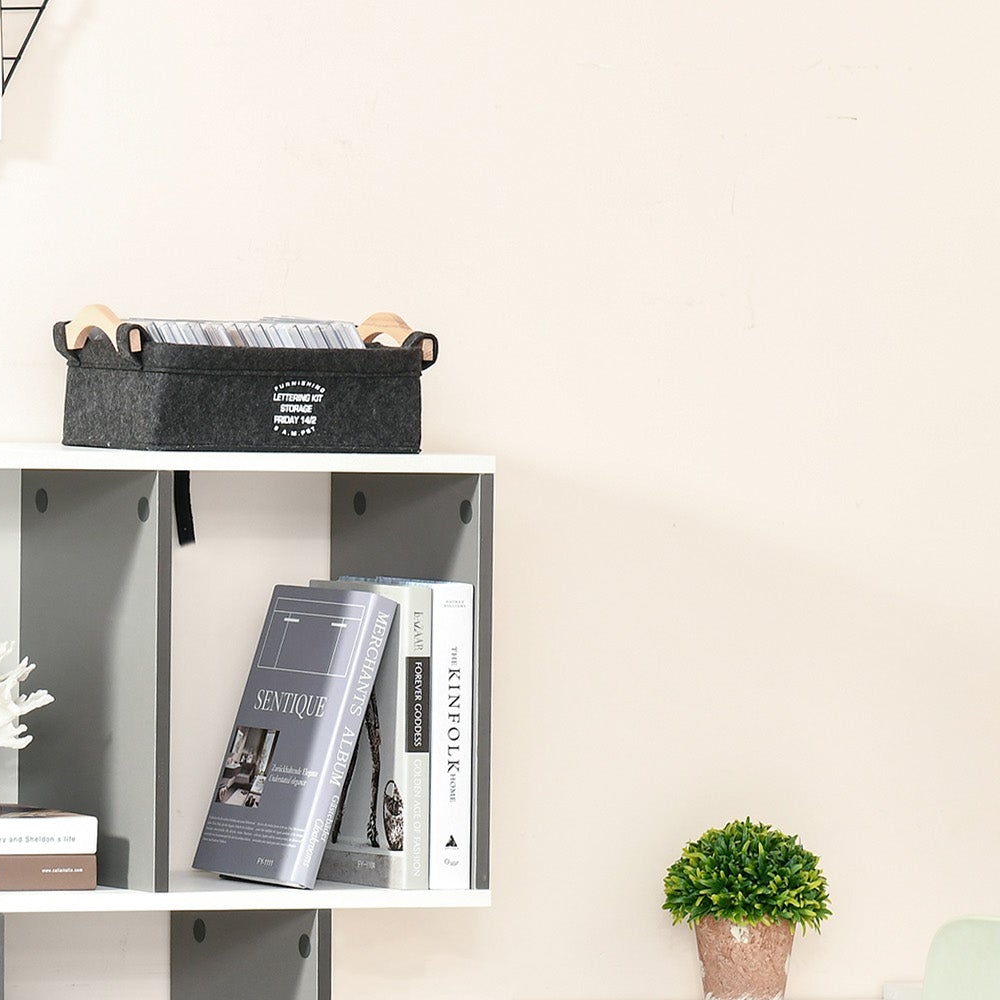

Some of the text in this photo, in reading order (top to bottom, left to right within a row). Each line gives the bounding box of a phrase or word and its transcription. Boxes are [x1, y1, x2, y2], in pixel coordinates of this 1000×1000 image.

[272, 392, 324, 402] LETTERING KIT
[280, 404, 313, 413] STORAGE
[273, 415, 317, 424] FRIDAY 14/2
[254, 688, 328, 719] SENTIQUE
[329, 611, 389, 788] MERCHANTS ALBUM
[414, 661, 423, 748] FOREVER GODDESS
[446, 667, 460, 773] KINFOLK
[449, 773, 457, 802] HOME
[412, 759, 422, 877] GOLDEN AGE OF FASHION
